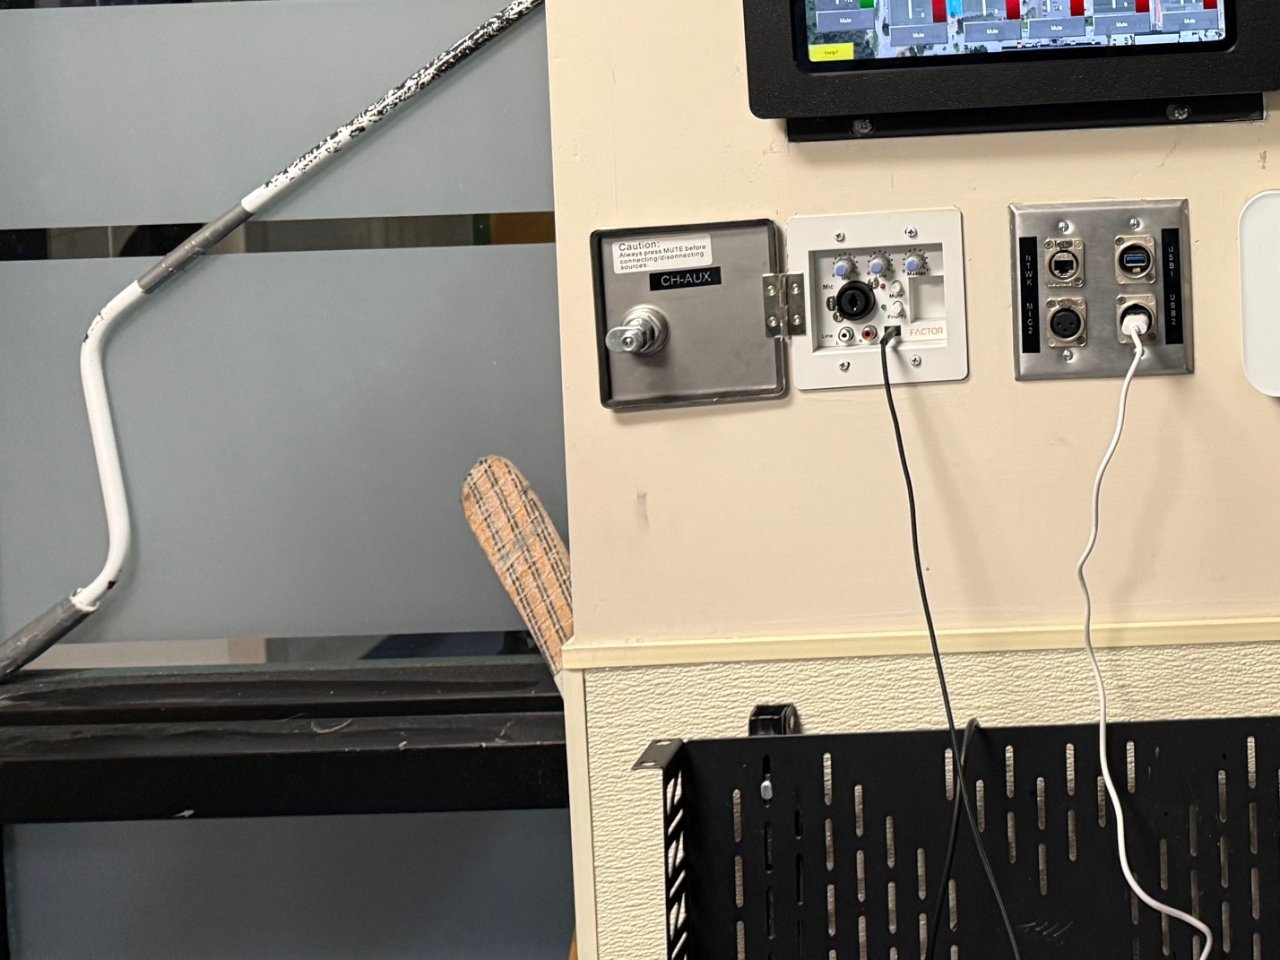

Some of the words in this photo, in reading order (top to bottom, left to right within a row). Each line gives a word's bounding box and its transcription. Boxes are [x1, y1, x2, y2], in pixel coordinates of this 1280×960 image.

[619, 241, 660, 252] Caution:
[664, 246, 684, 254] MUTE
[685, 244, 707, 252] before
[620, 263, 648, 271] sources.
[1025, 255, 1033, 286] NTWK
[661, 272, 712, 286] CH-AUX
[1026, 303, 1034, 335] MIC2
[910, 327, 943, 336] FACTOR
